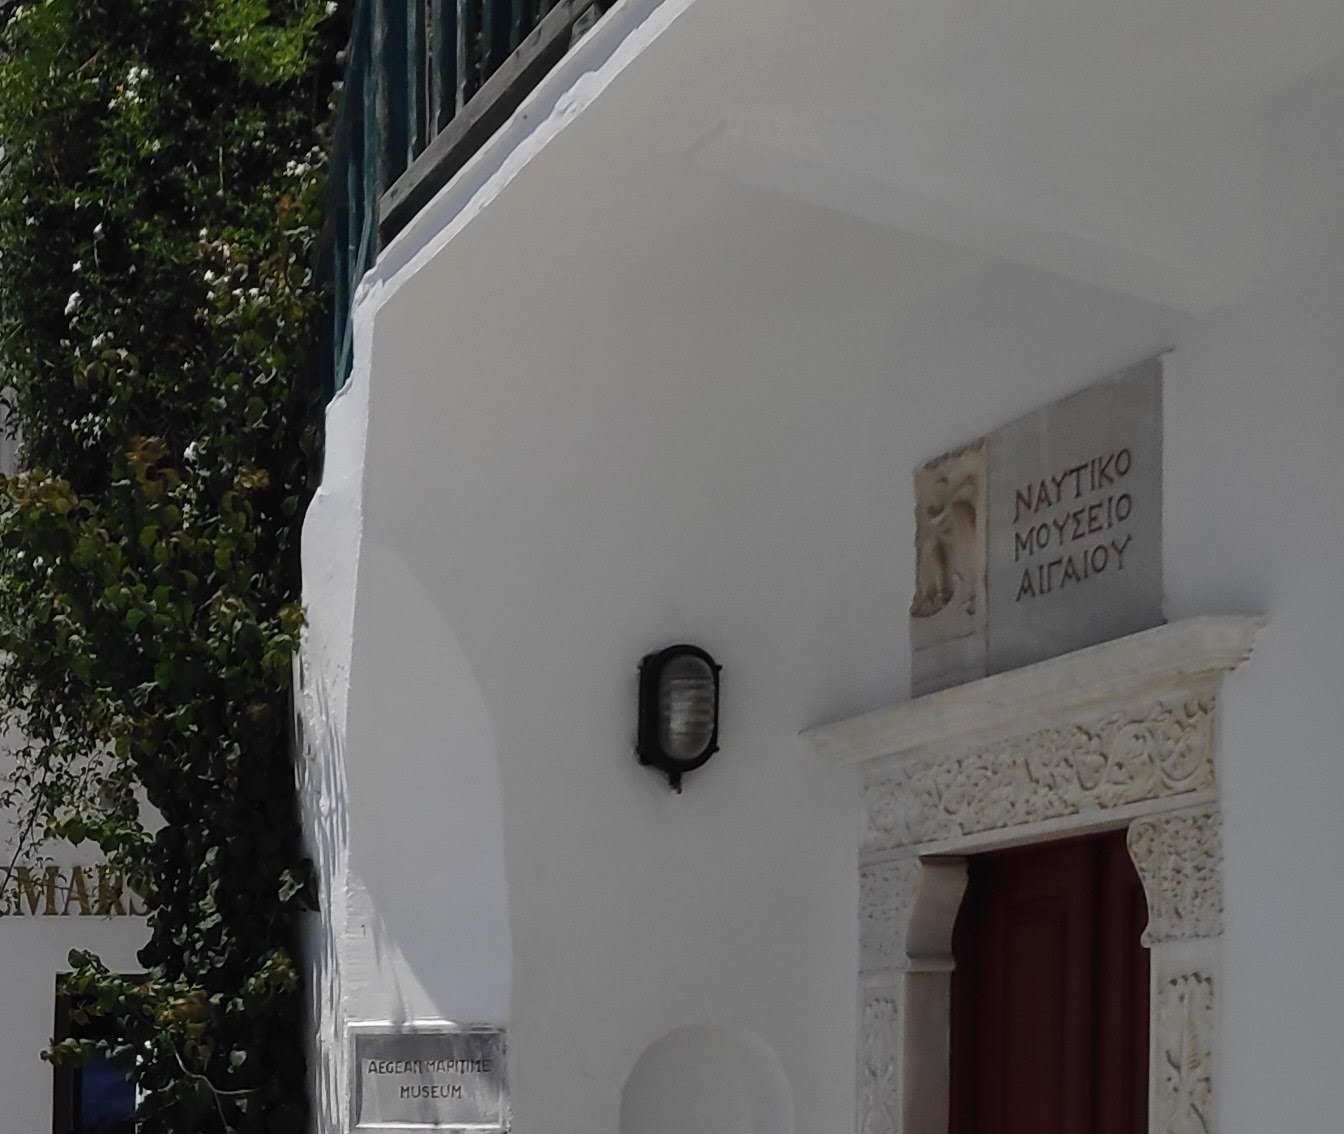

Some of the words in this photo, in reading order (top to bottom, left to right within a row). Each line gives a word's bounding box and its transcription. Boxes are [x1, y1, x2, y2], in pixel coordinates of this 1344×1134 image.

[1012, 448, 1132, 525] ΝΑΥΤΙΚΟ
[1014, 493, 1132, 563] ΜΟΥΣΕΙΟ
[1015, 533, 1133, 602] ΑΙΓΑΙΟΥ
[368, 1060, 422, 1074] AEGEAN
[400, 1085, 462, 1099] MUSEUM
